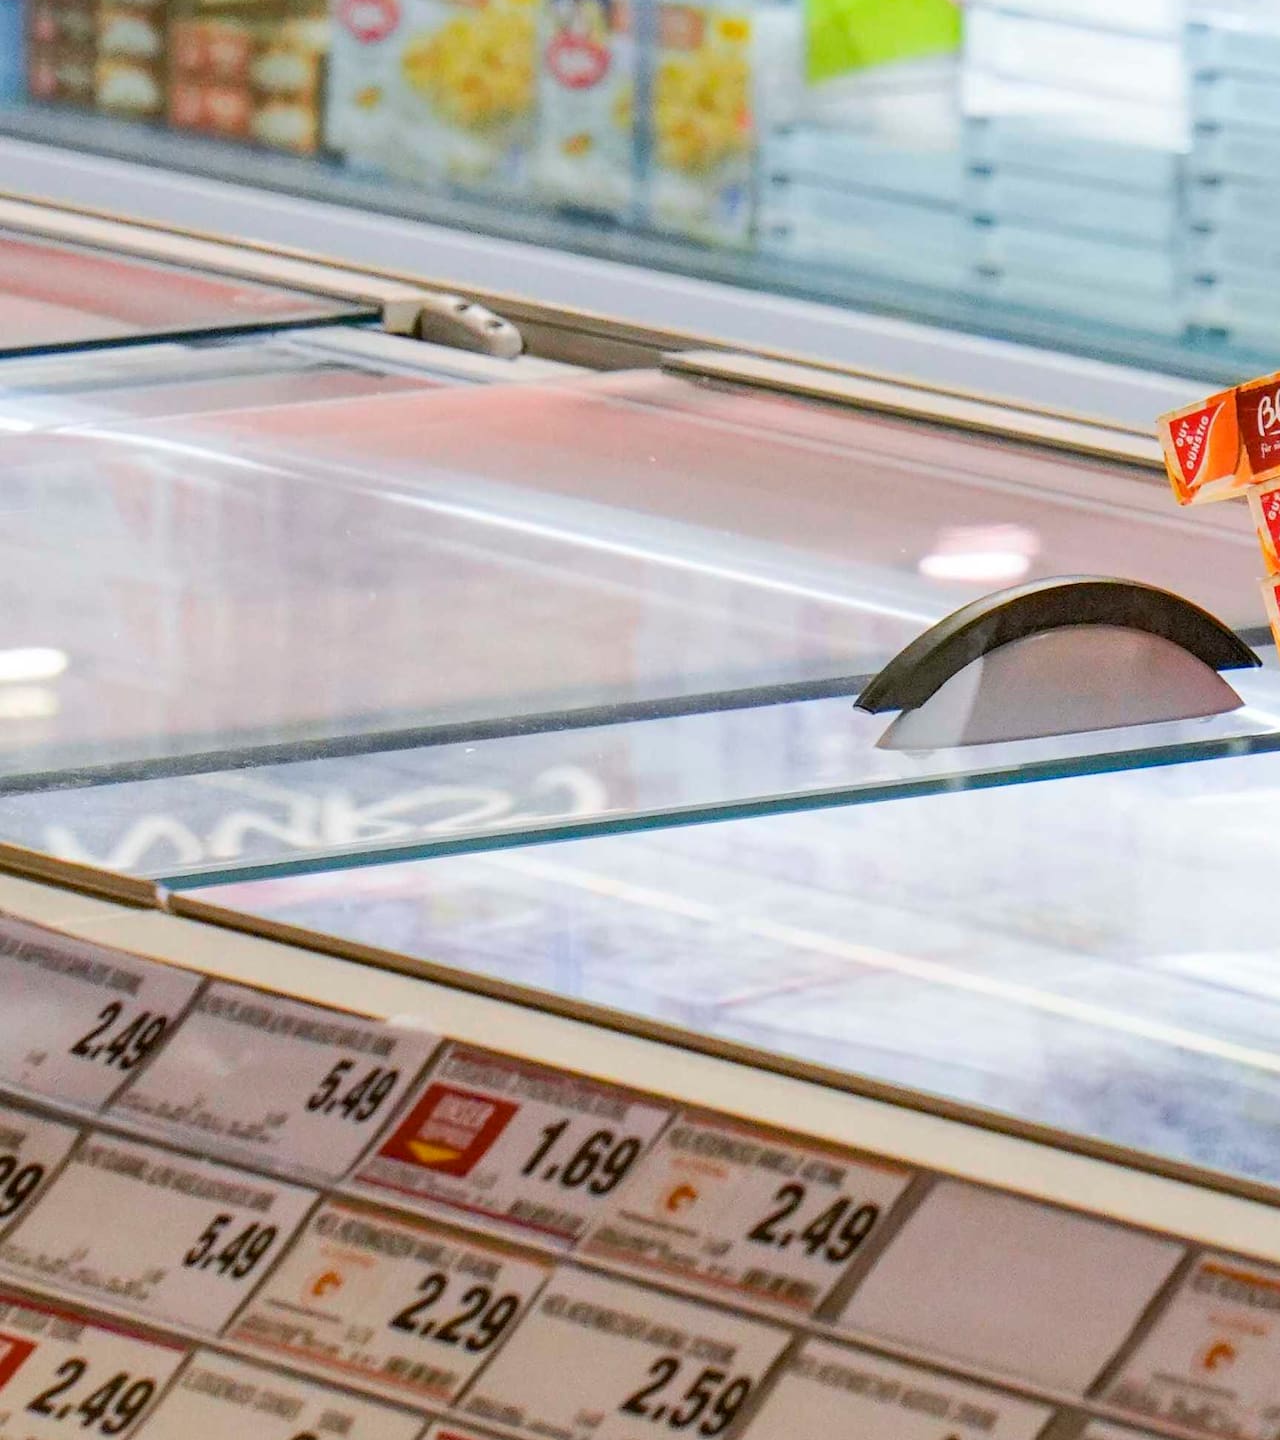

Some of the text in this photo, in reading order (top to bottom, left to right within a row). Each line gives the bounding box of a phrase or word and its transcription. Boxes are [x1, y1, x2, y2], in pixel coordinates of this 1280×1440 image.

[1176, 420, 1191, 448] GUT
[1186, 415, 1210, 470] GÜNSTIG
[70, 1000, 168, 1071] 2.49
[307, 1058, 400, 1120] 5.49
[520, 1118, 643, 1197] 1.69
[183, 1213, 278, 1280] 5.49
[746, 1183, 882, 1263] 2.49
[388, 1272, 520, 1353] 2.29
[26, 1357, 158, 1436] 2.49
[618, 1356, 755, 1437] 2.59
